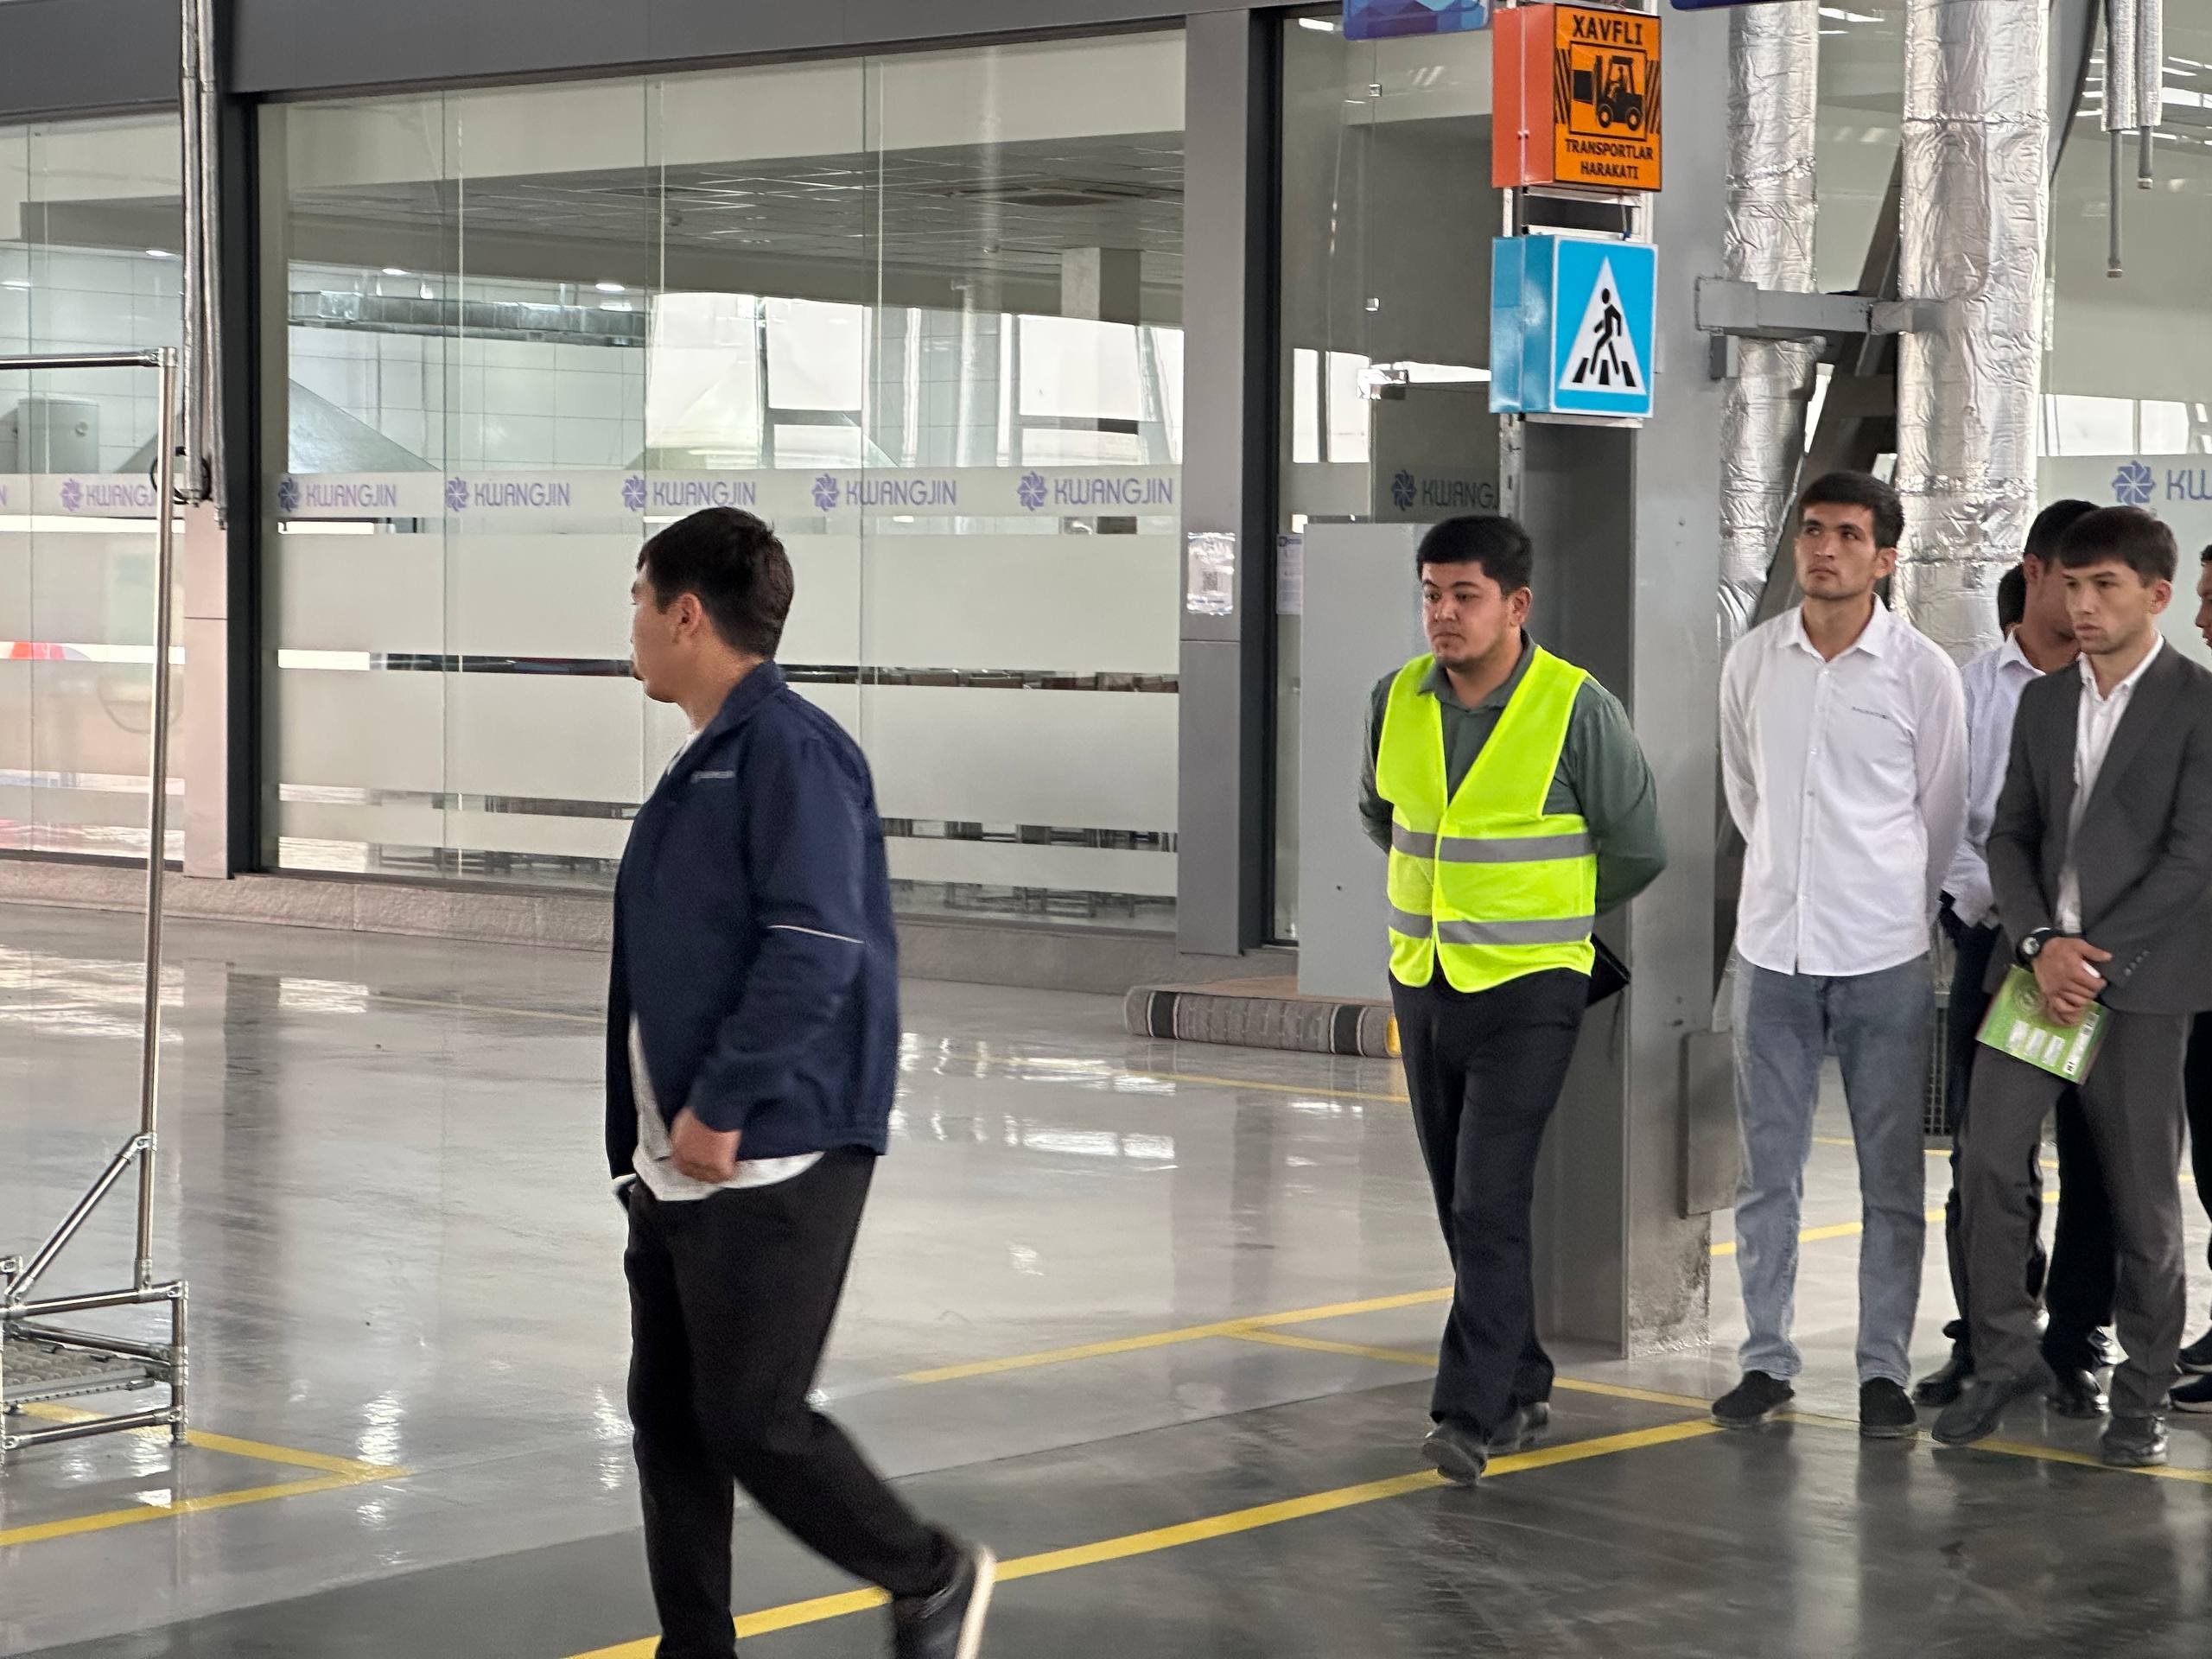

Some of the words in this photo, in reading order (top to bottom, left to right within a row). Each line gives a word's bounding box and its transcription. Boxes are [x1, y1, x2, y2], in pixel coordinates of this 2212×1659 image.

[1573, 15, 1643, 44] XAVFLI
[1566, 139, 1654, 161] TRANSPORTLAR
[1580, 162, 1639, 180] HARAKATI
[86, 484, 157, 507] KWANGJ
[306, 484, 397, 507] KWANGJIN
[474, 482, 570, 506] KWANGJIN
[653, 481, 756, 506] KWANGJIN
[846, 480, 957, 505] KWANGJIN
[1054, 478, 1173, 505] KWANGJIN
[1421, 480, 1500, 509] KWANGJ
